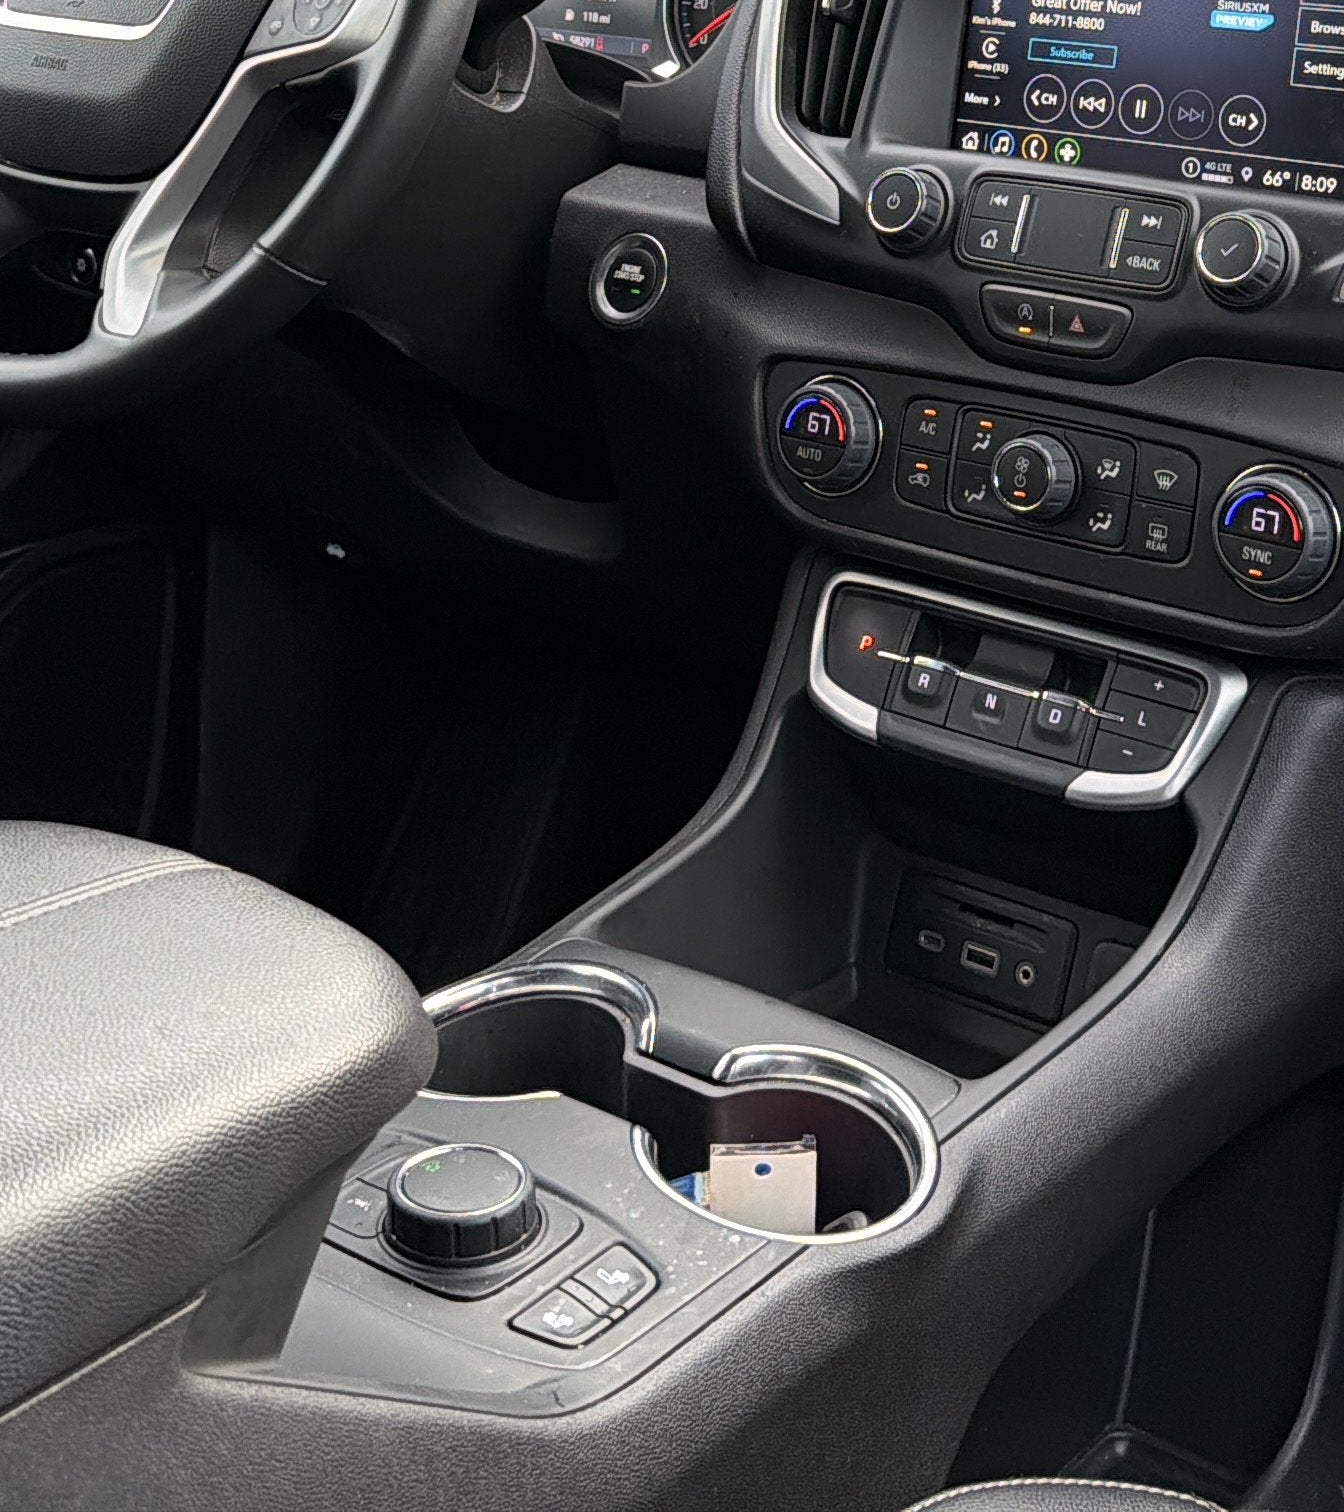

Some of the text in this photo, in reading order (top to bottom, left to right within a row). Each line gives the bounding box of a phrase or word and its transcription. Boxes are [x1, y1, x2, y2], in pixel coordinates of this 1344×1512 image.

[1106, 0, 1142, 16] Now!
[1217, 0, 1270, 14] SIRIUSXM
[991, 17, 1016, 28] iPhone
[1028, 12, 1105, 31] 844-711-8800
[1050, 47, 1094, 60] Subscribe
[967, 60, 992, 71] iPhone
[964, 93, 989, 106] More
[1040, 91, 1057, 106] CH
[1228, 114, 1246, 127] CH
[1204, 161, 1232, 173] 4G LTE
[1262, 169, 1291, 187] 66°
[1301, 174, 1338, 194] 8:09
[1133, 255, 1162, 272] BACK
[807, 413, 831, 436] 67
[919, 420, 938, 436] A/C
[796, 445, 823, 464] AUTO
[1252, 509, 1280, 535] 67
[1145, 538, 1169, 552] REAR
[1242, 546, 1273, 566] SYNC
[859, 634, 876, 652] P
[917, 673, 930, 688] R
[985, 694, 997, 709] N
[1048, 709, 1062, 724] D
[1137, 711, 1147, 727] L
